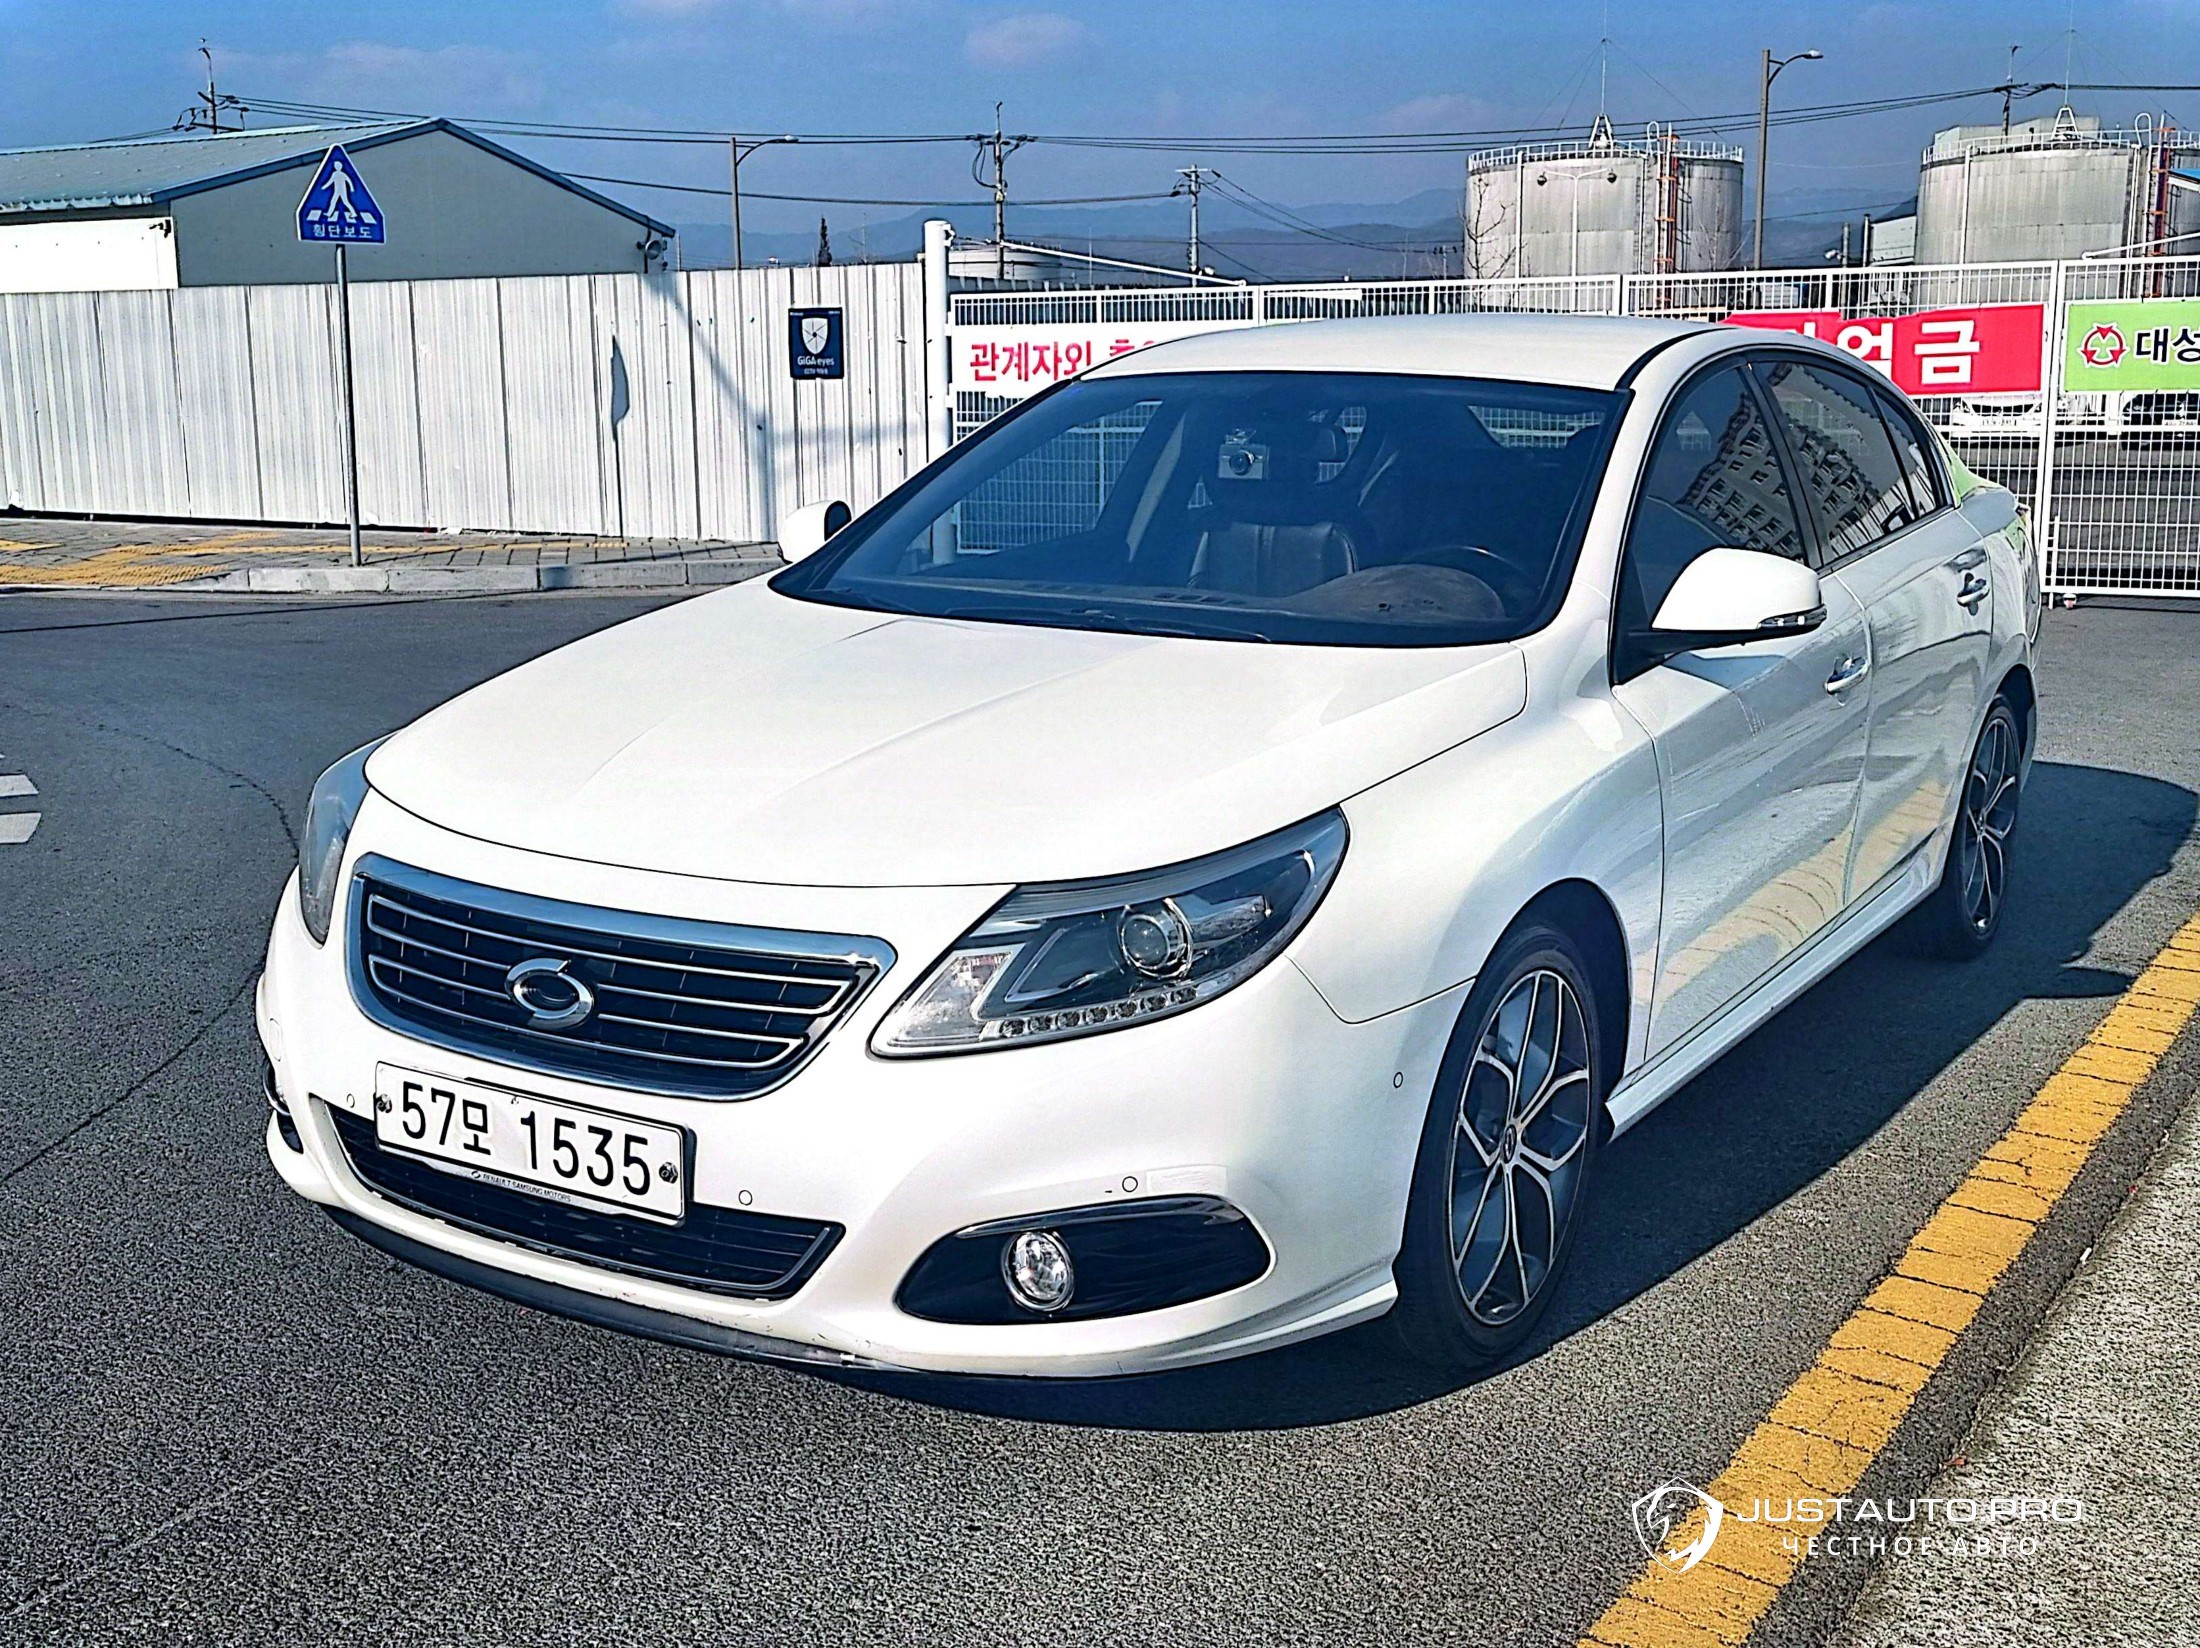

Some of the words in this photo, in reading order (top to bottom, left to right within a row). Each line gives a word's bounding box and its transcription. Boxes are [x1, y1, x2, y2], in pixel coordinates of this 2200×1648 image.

[313, 223, 372, 239] 횡단보도
[817, 358, 835, 367] eyes
[970, 339, 1092, 382] 관계자외
[1784, 319, 1981, 385] 엄금
[402, 1080, 492, 1156] 57모
[520, 1110, 651, 1196] 1535
[483, 1173, 511, 1187] RENAULT
[512, 1181, 543, 1195] SAMSUNG
[543, 1189, 571, 1202] MOTORS
